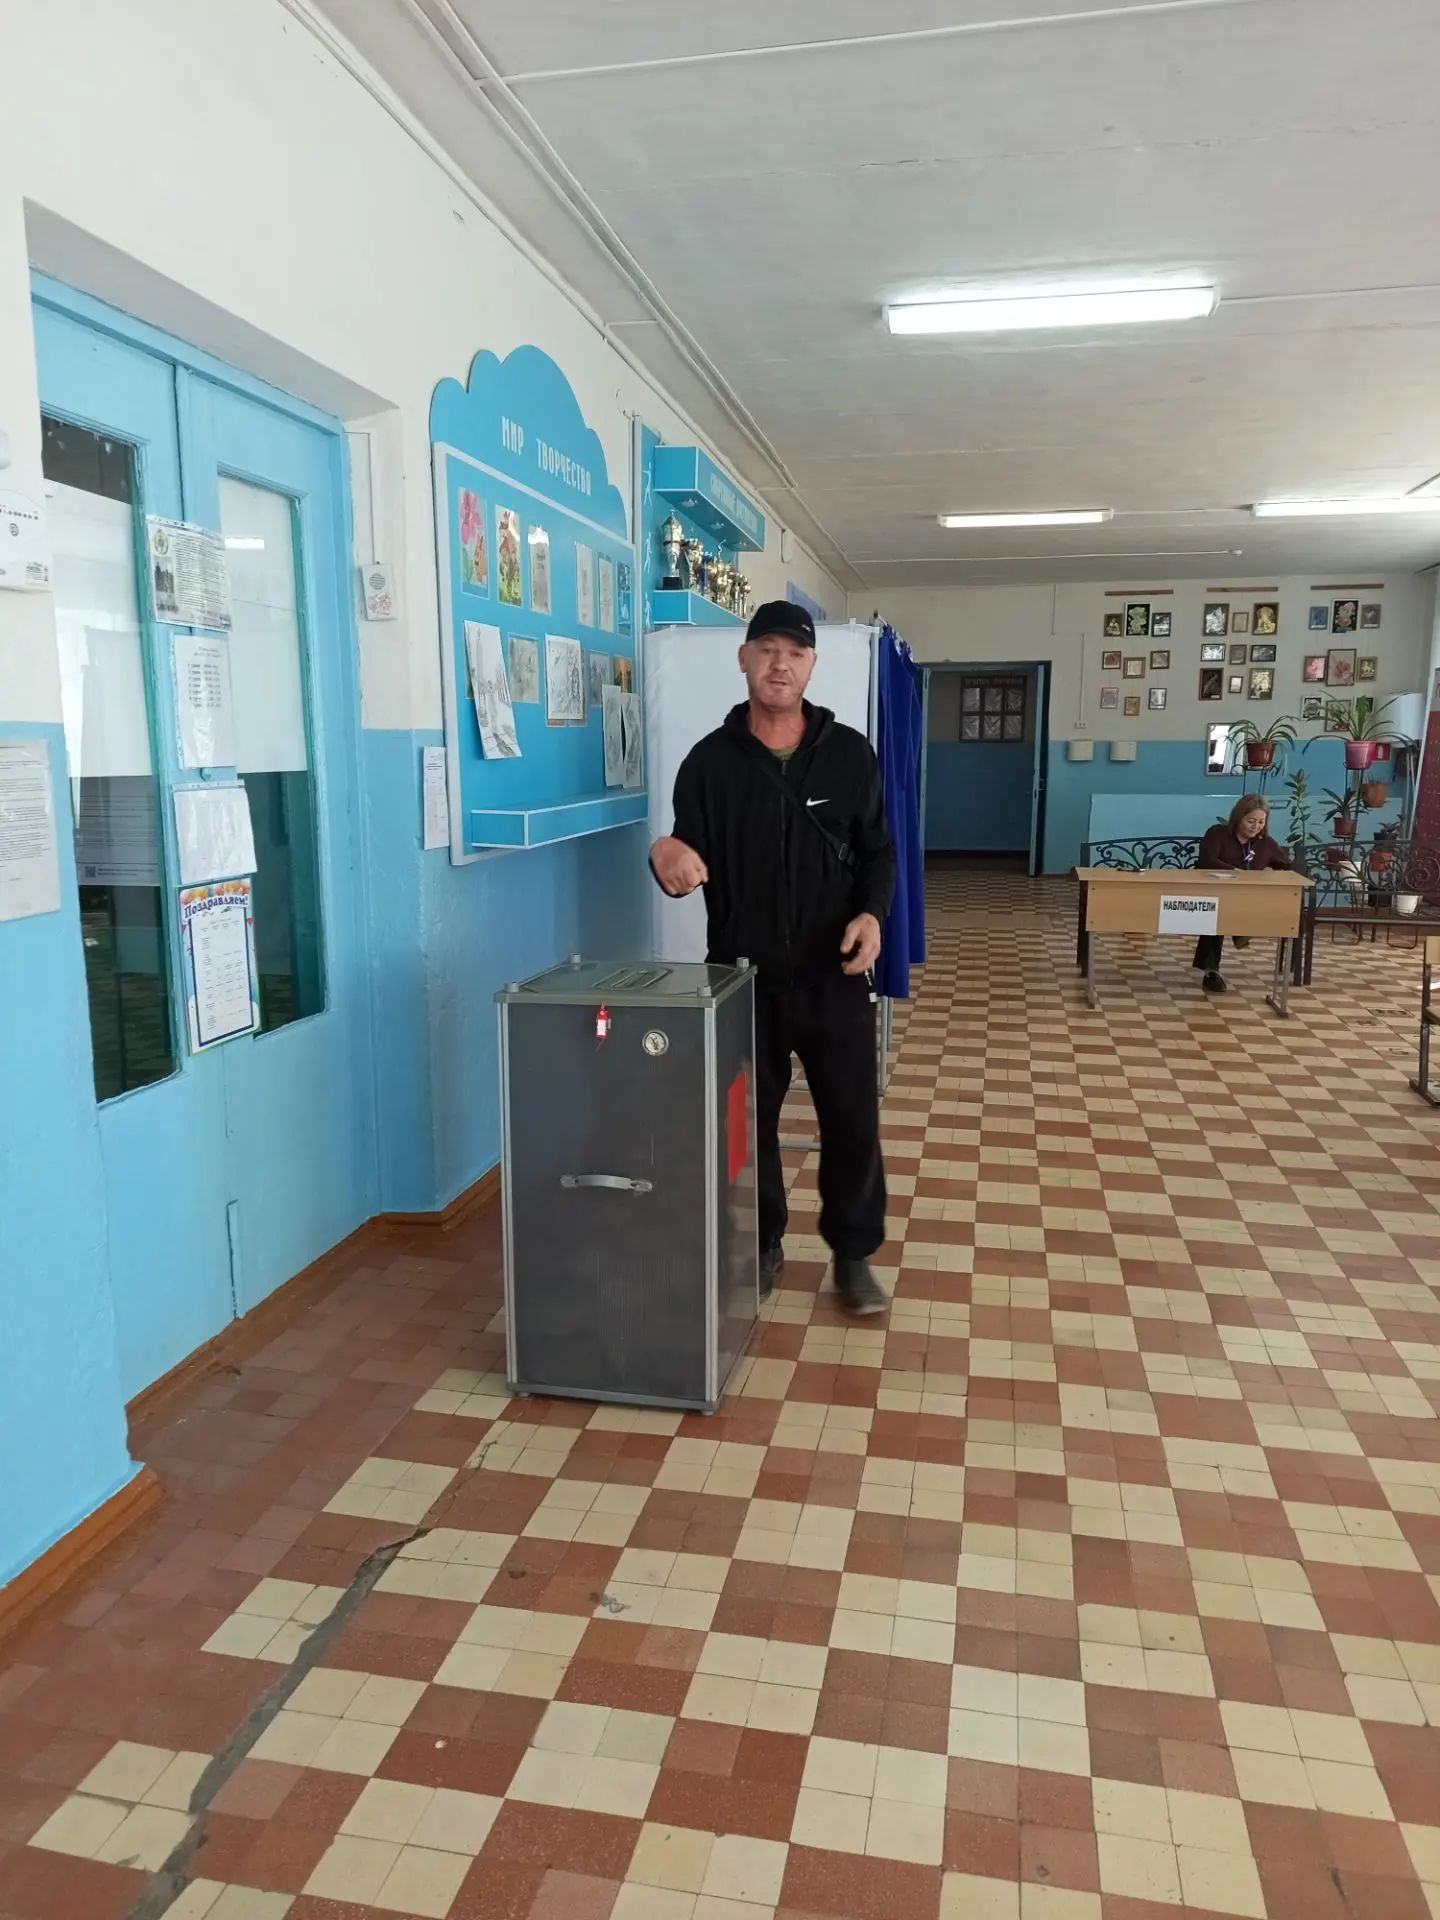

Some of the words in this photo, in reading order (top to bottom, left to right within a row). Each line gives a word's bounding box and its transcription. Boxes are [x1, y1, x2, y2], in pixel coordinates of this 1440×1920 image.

[502, 416, 524, 455] МИР
[184, 896, 248, 919] Поздравляем!
[1164, 901, 1216, 912] НАБЛЮДАТЕЛИ
